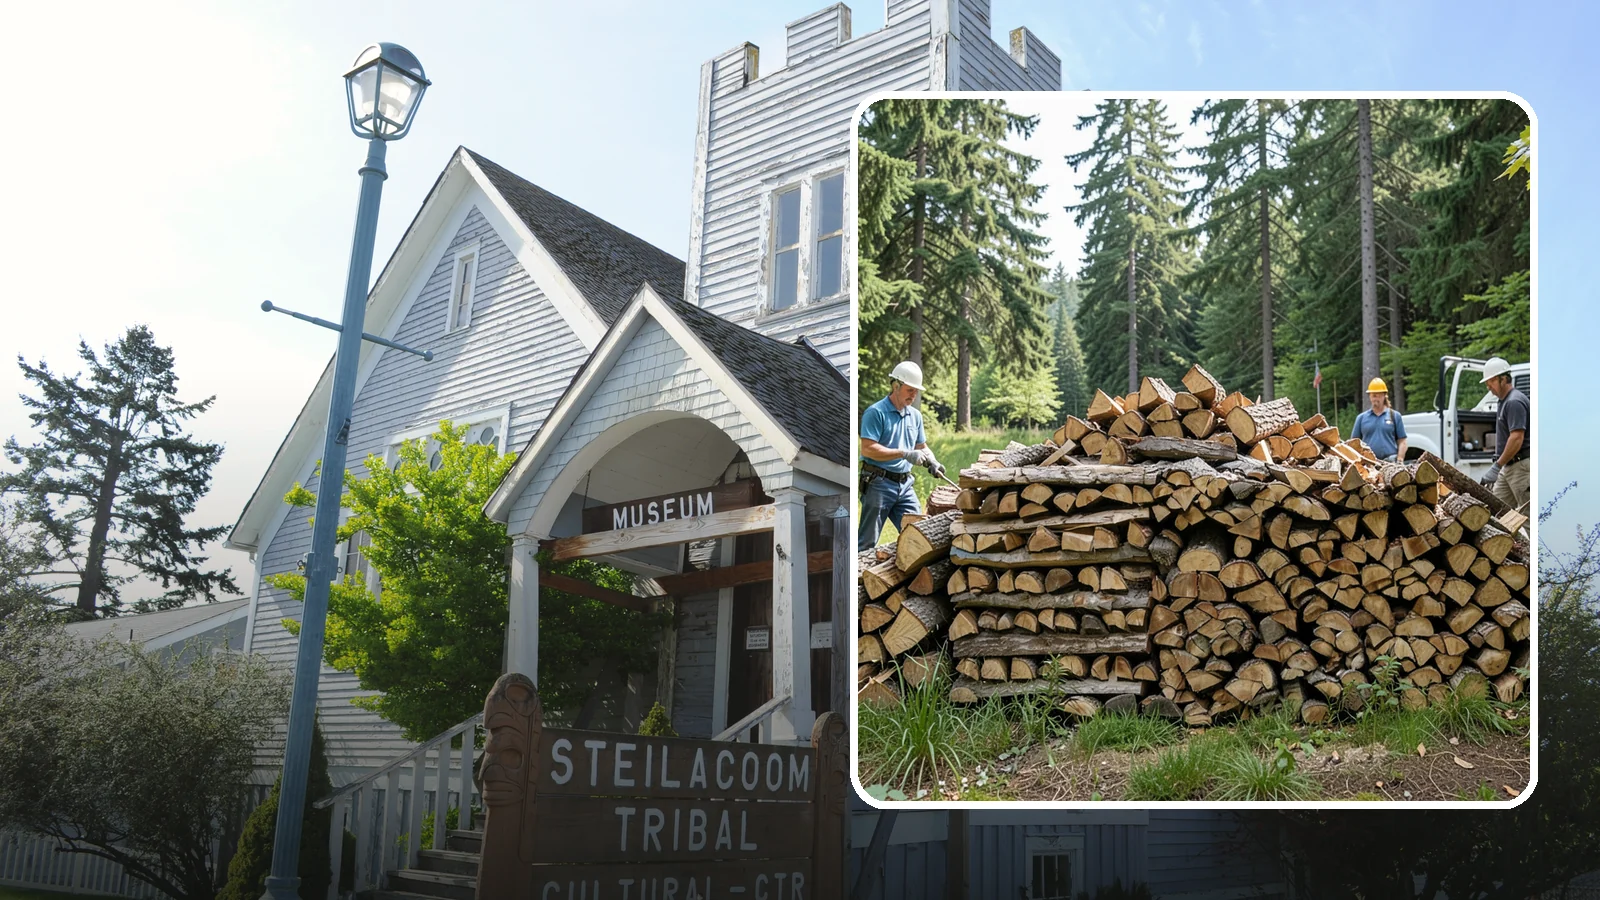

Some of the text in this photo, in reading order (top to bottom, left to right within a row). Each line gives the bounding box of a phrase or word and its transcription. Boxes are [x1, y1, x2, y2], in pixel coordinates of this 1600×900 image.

[612, 491, 713, 531] MUSEUM
[550, 738, 809, 792] STEILACOOM
[615, 806, 758, 851] TRIBAL
